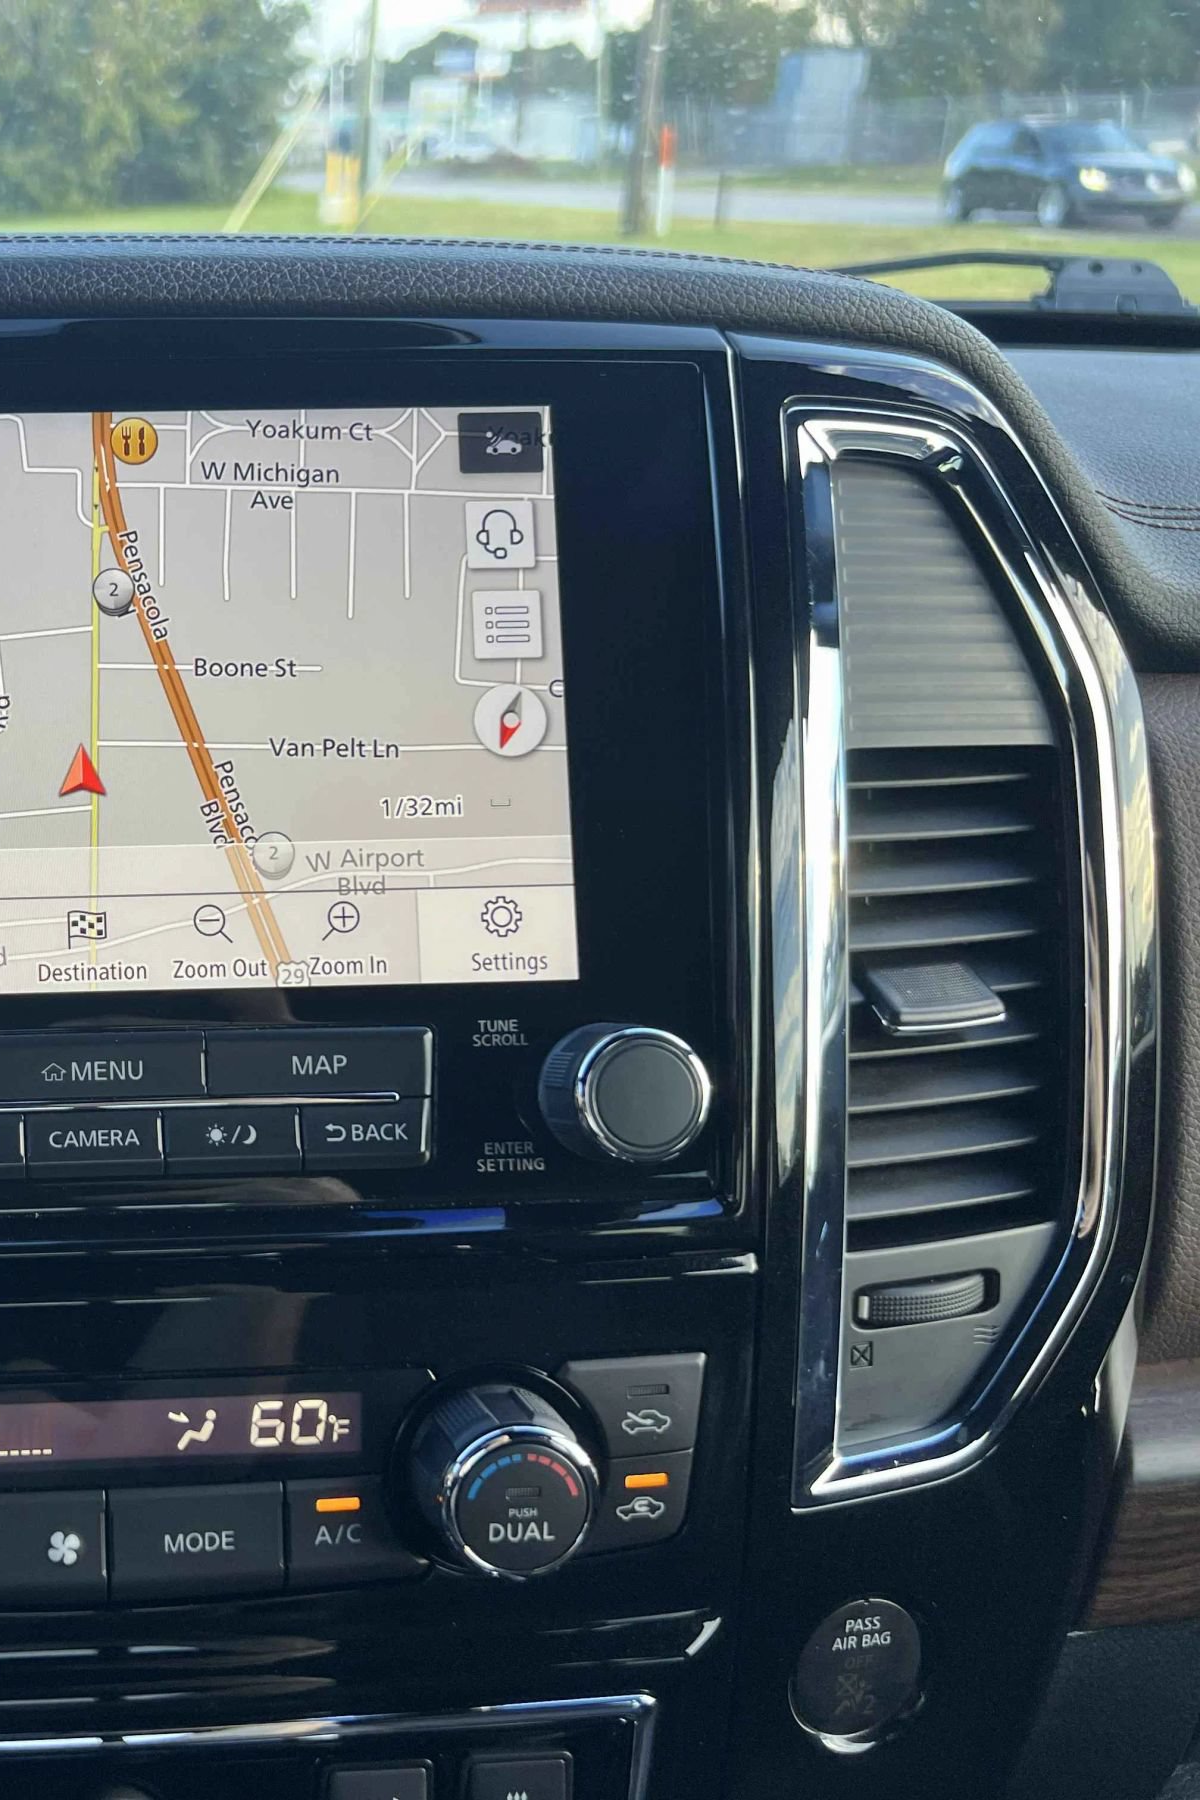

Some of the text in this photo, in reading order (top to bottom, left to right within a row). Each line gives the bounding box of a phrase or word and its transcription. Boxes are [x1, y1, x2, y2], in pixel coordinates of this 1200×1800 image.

[247, 420, 373, 442] Yoakum Ct
[201, 462, 340, 488] W Michigan
[250, 491, 294, 510] Ave
[108, 582, 119, 597] 2
[119, 531, 170, 640] Pensacola
[194, 659, 297, 679] Boone St
[269, 738, 399, 758] Van Pelt Ln
[214, 760, 261, 860] Pensaco
[380, 797, 463, 818] 1/32mi
[200, 800, 235, 848] Blvd
[268, 846, 279, 860] 2
[305, 848, 425, 872] W Airport
[338, 875, 386, 896] Blvd
[38, 961, 147, 982] Destination
[172, 957, 268, 979] Zoom Out
[310, 956, 388, 976] Zoom In
[471, 952, 548, 974] Settings
[282, 967, 305, 986] 29
[477, 1019, 519, 1033] TUNE
[472, 1032, 529, 1047] SCROLL
[71, 1060, 144, 1081] MENU
[291, 1054, 348, 1076] MAP
[49, 1128, 140, 1148] CAMERA
[351, 1122, 408, 1142] BACK
[484, 1141, 535, 1156] ENTER
[476, 1157, 545, 1173] SETTING
[508, 1507, 539, 1518] PUSH
[164, 1530, 236, 1553] MODE
[314, 1523, 362, 1546] A/C
[488, 1521, 555, 1544] DUAL
[845, 1616, 881, 1633] PASS
[832, 1631, 891, 1651] AIR BAG
